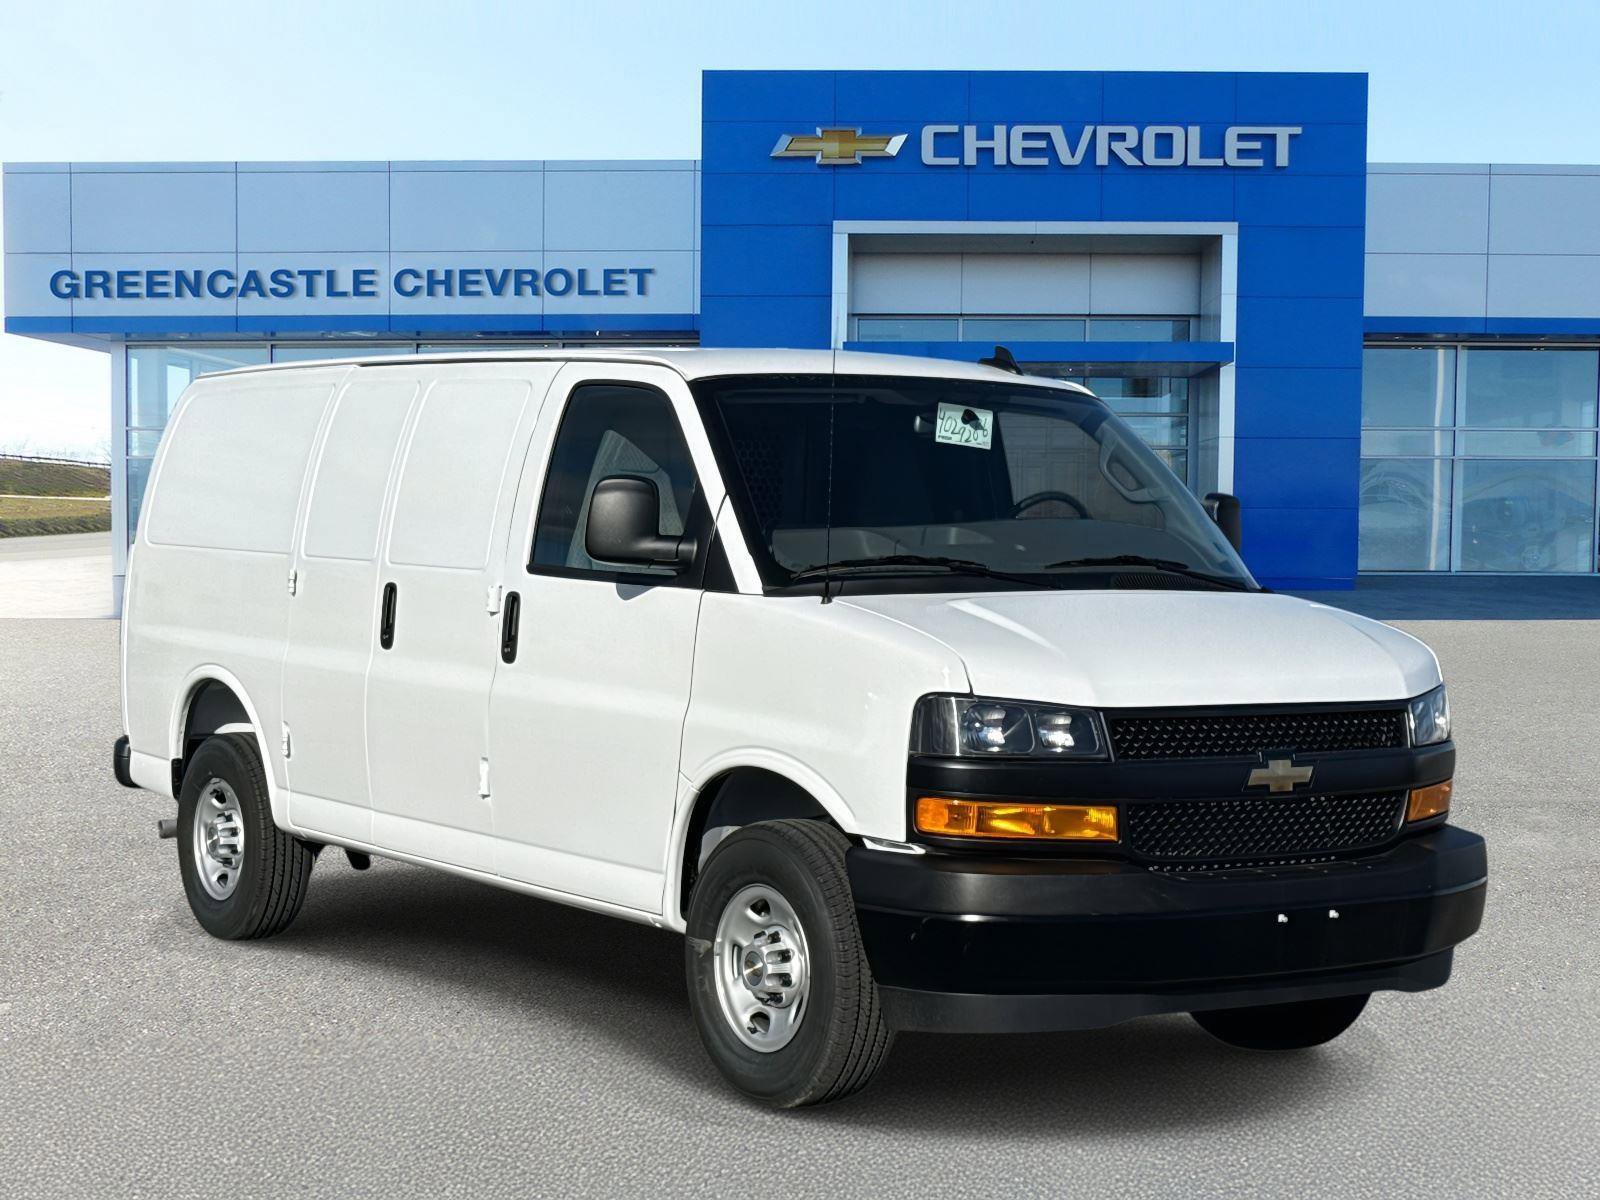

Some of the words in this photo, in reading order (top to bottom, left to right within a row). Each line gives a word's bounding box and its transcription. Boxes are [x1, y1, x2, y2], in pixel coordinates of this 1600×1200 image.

[921, 125, 1302, 167] CHEVROLET
[50, 269, 377, 298] GREENCASTLE
[394, 268, 655, 297] CHEVROLET
